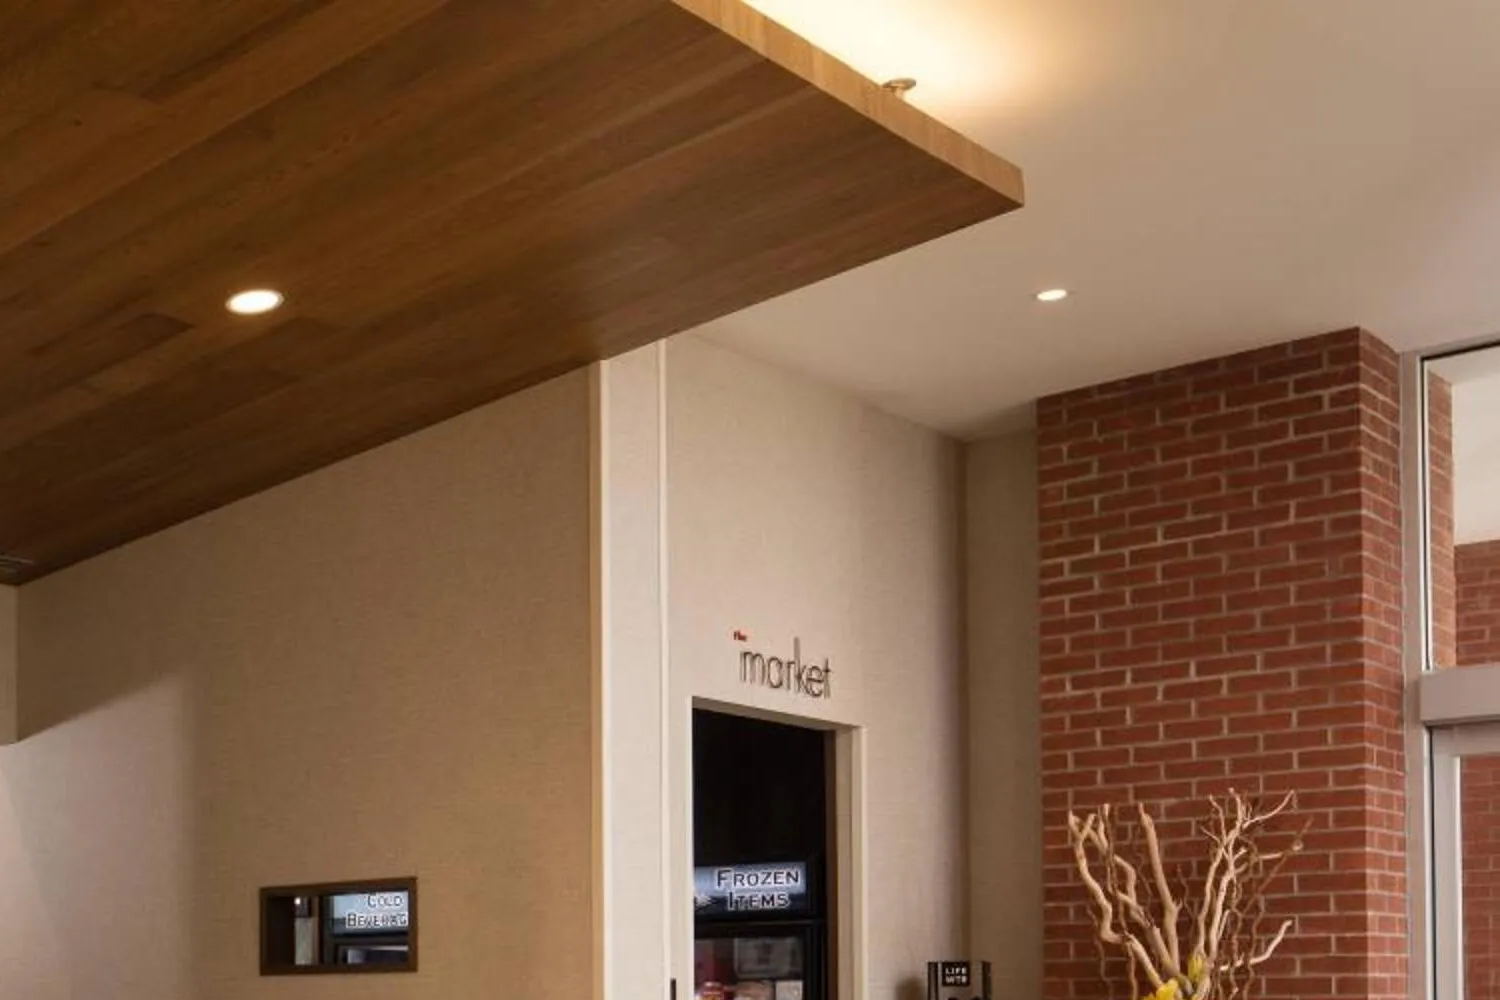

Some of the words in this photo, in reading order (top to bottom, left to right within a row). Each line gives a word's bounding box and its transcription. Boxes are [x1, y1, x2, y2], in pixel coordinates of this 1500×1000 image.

[740, 636, 832, 698] market
[717, 868, 800, 888] FROZEN
[367, 893, 403, 909] COLD
[728, 890, 790, 909] ITEMS
[347, 912, 407, 928] BEVERAG
